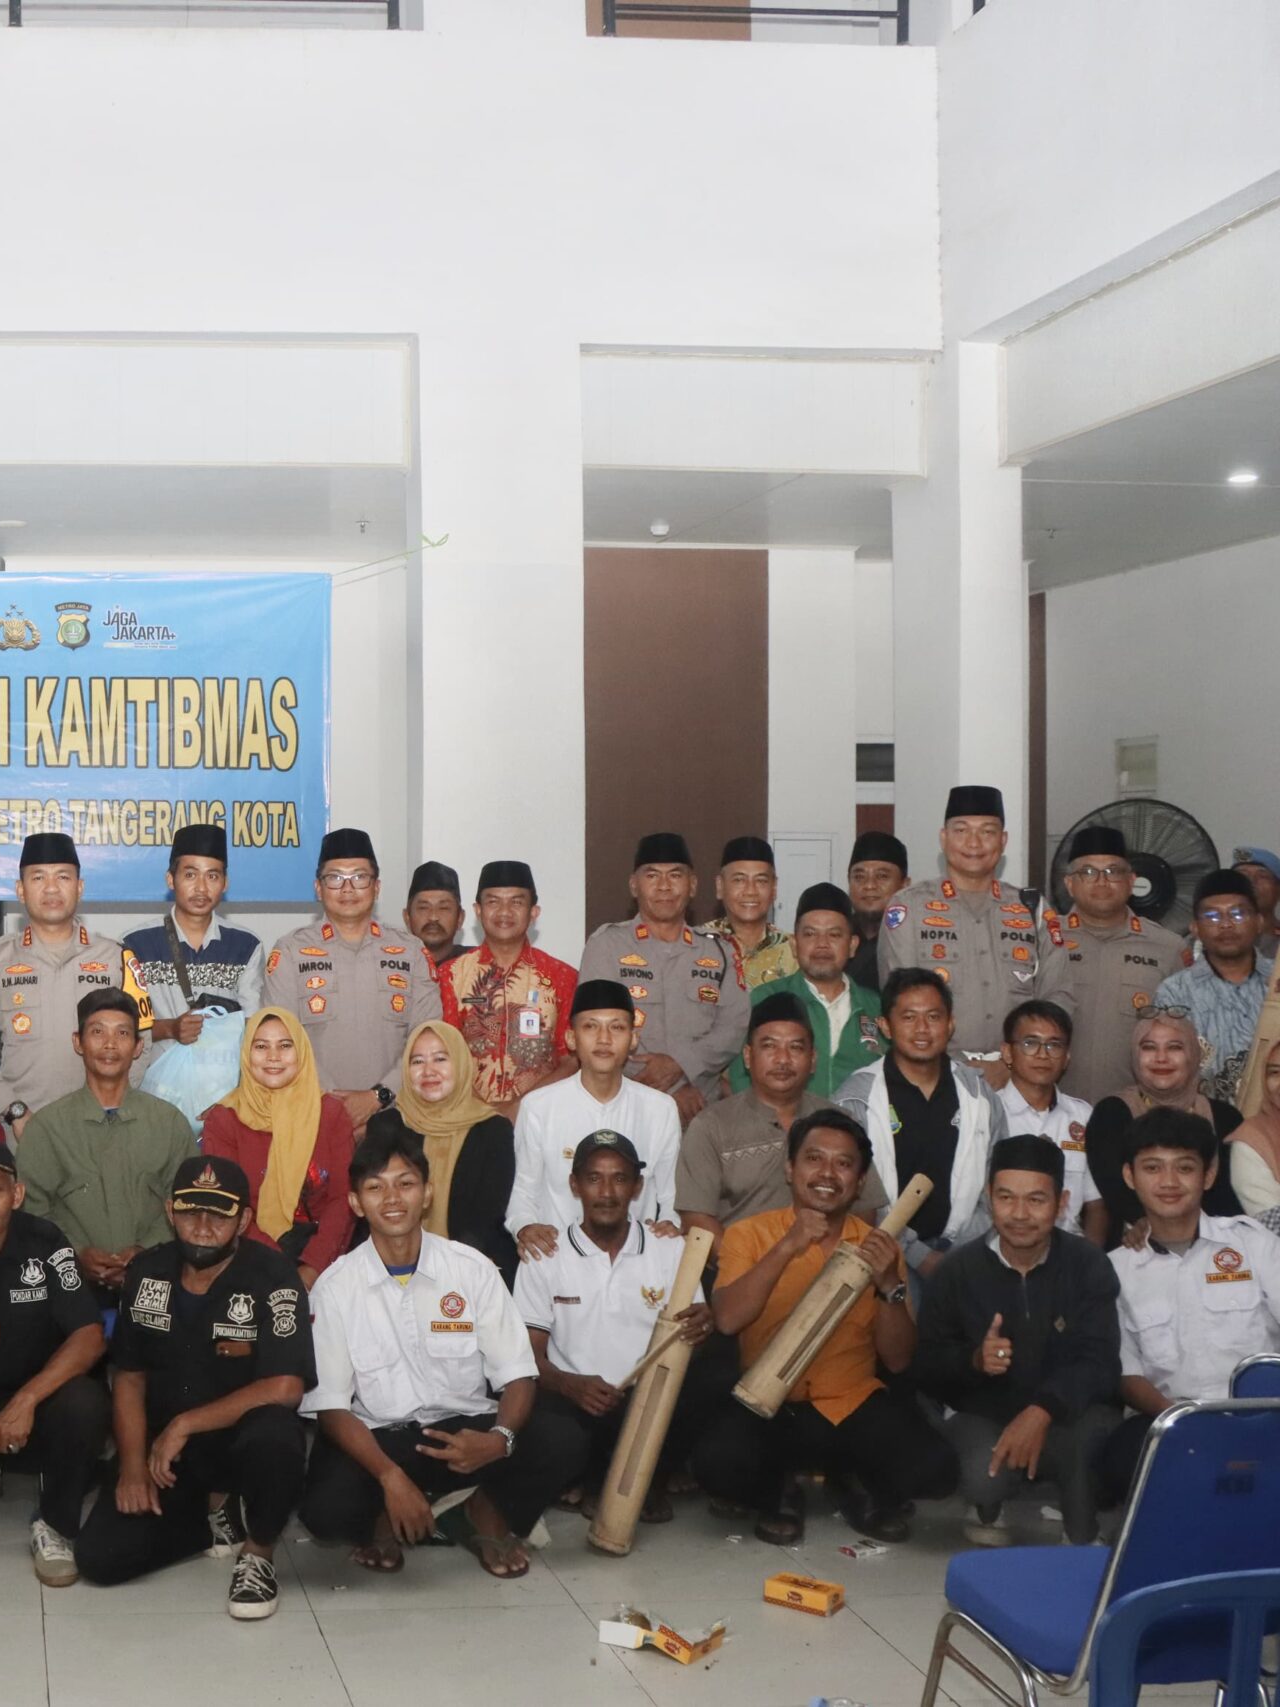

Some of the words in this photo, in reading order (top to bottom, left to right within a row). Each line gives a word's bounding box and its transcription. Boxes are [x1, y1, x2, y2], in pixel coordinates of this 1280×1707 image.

[103, 608, 137, 627] JAGA
[24, 676, 300, 772] KAMTIBMAS
[69, 799, 227, 848] TANGERANG
[232, 801, 301, 849] KOTA
[920, 930, 958, 941] NOPTA
[1000, 932, 1036, 944] POLRI
[298, 961, 333, 973] IMRON
[380, 960, 410, 972] POLRI
[1124, 954, 1159, 967] POLRI
[78, 974, 111, 986] POLRI
[691, 969, 721, 980] POLR
[142, 1279, 169, 1291] TURN
[137, 1299, 165, 1309] CRIME
